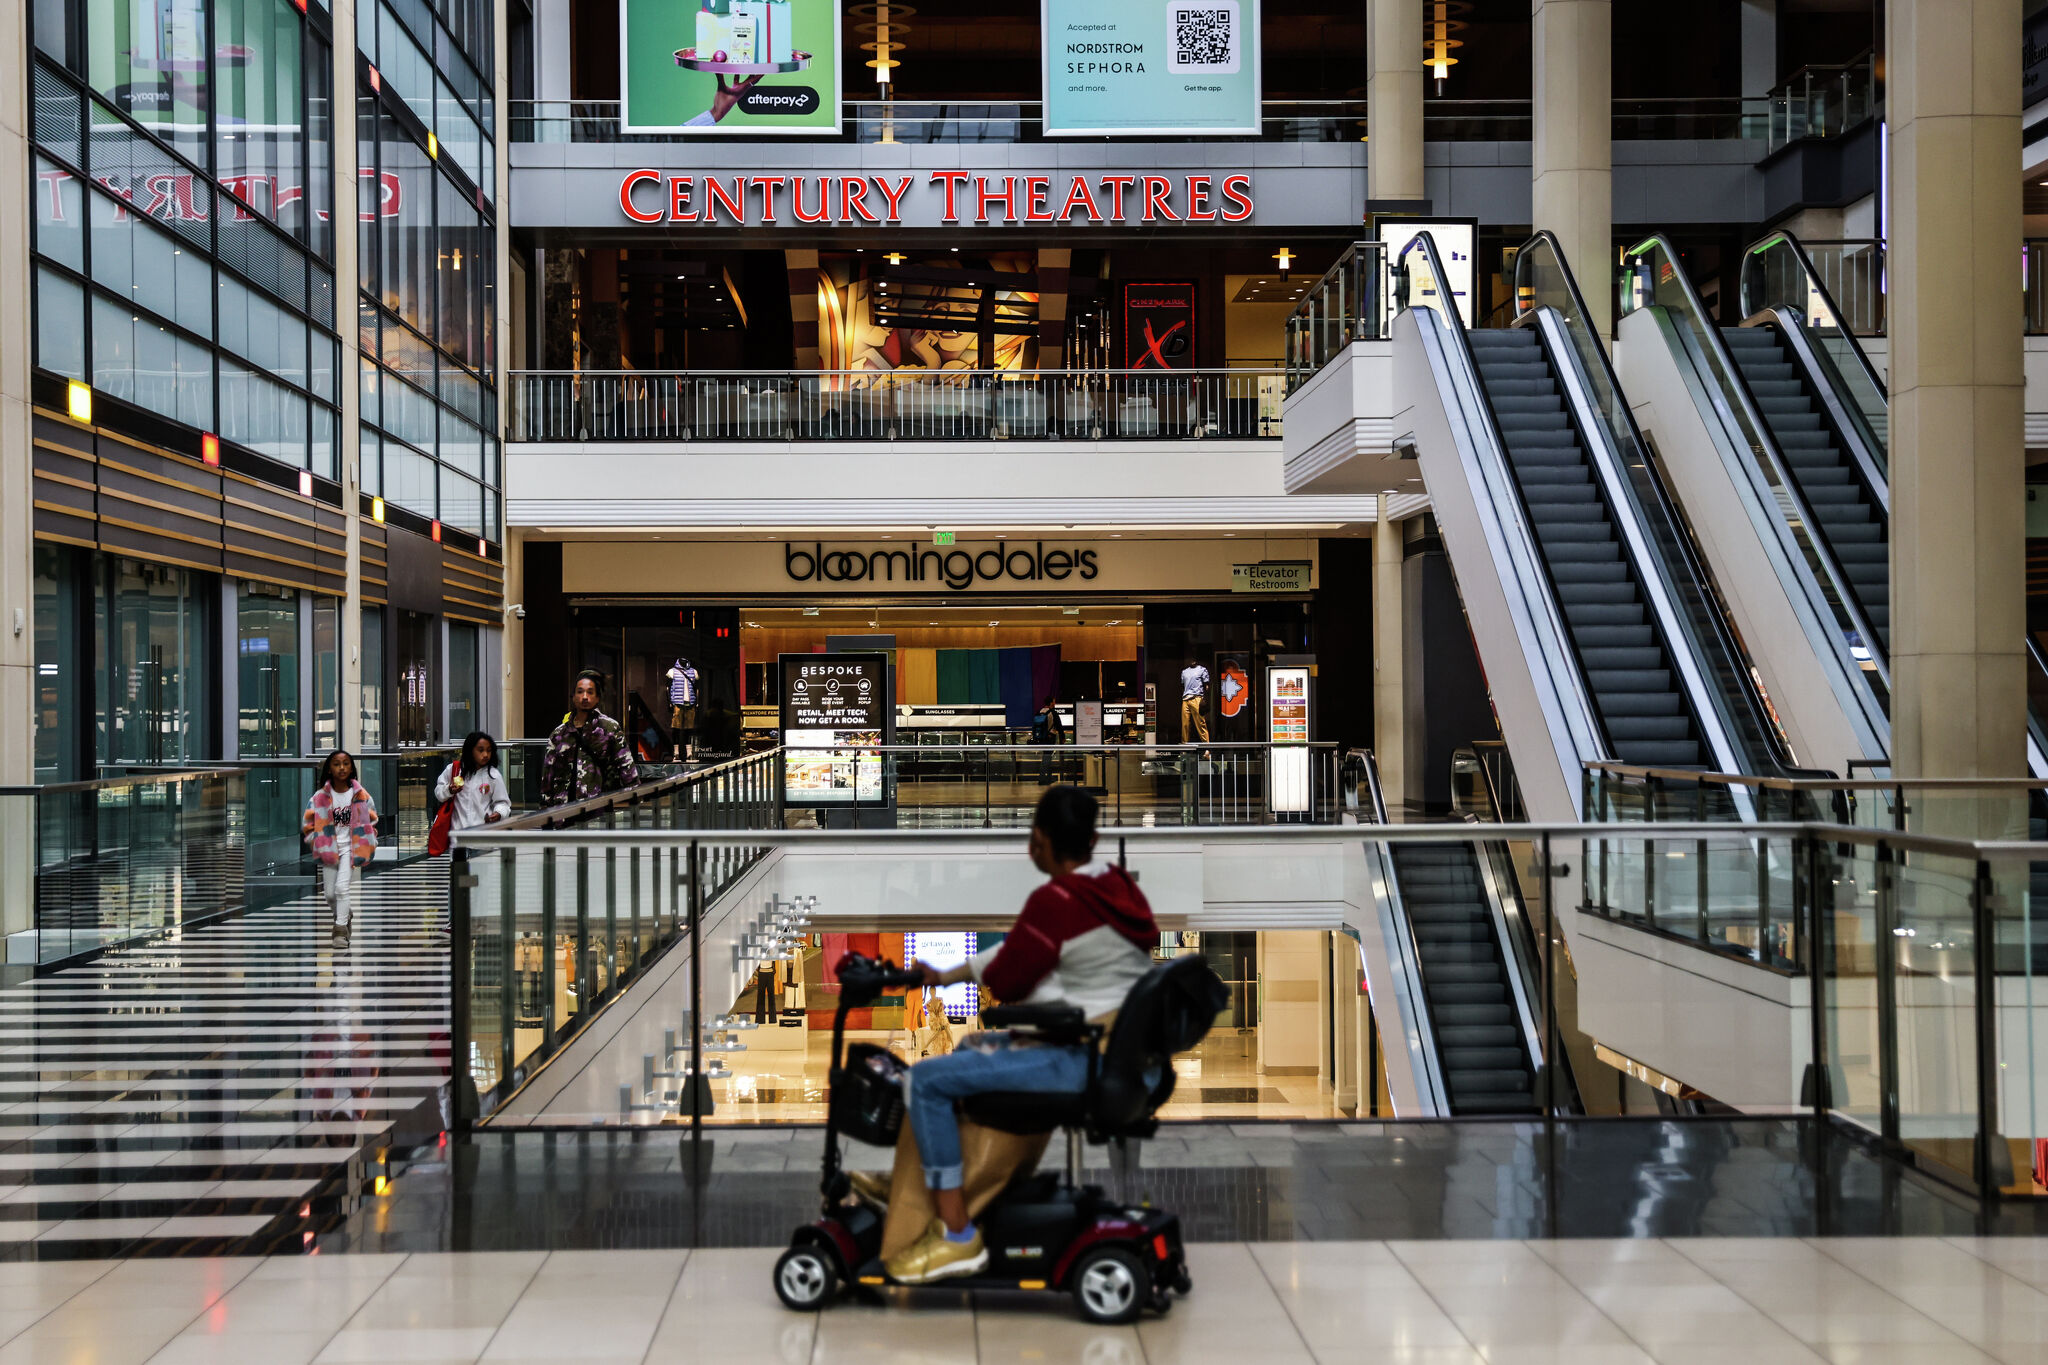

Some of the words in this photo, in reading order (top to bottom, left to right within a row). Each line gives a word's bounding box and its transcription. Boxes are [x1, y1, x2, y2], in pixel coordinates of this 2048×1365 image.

[1067, 23, 1107, 32] Accepted
[1067, 43, 1143, 54] NORDSTROM
[1067, 62, 1146, 74] SEPHORA
[1068, 84, 1084, 92] and
[747, 93, 797, 107] afterpay
[619, 168, 914, 224] CENTURY
[929, 169, 1254, 223] THEATRES
[936, 532, 952, 544] EXIT
[785, 541, 1099, 591] bloomingdale's
[1249, 566, 1299, 578] Elevator
[1249, 579, 1299, 589] Restrooms
[801, 666, 863, 675] BESPOKE
[797, 709, 825, 717] RETAIL,
